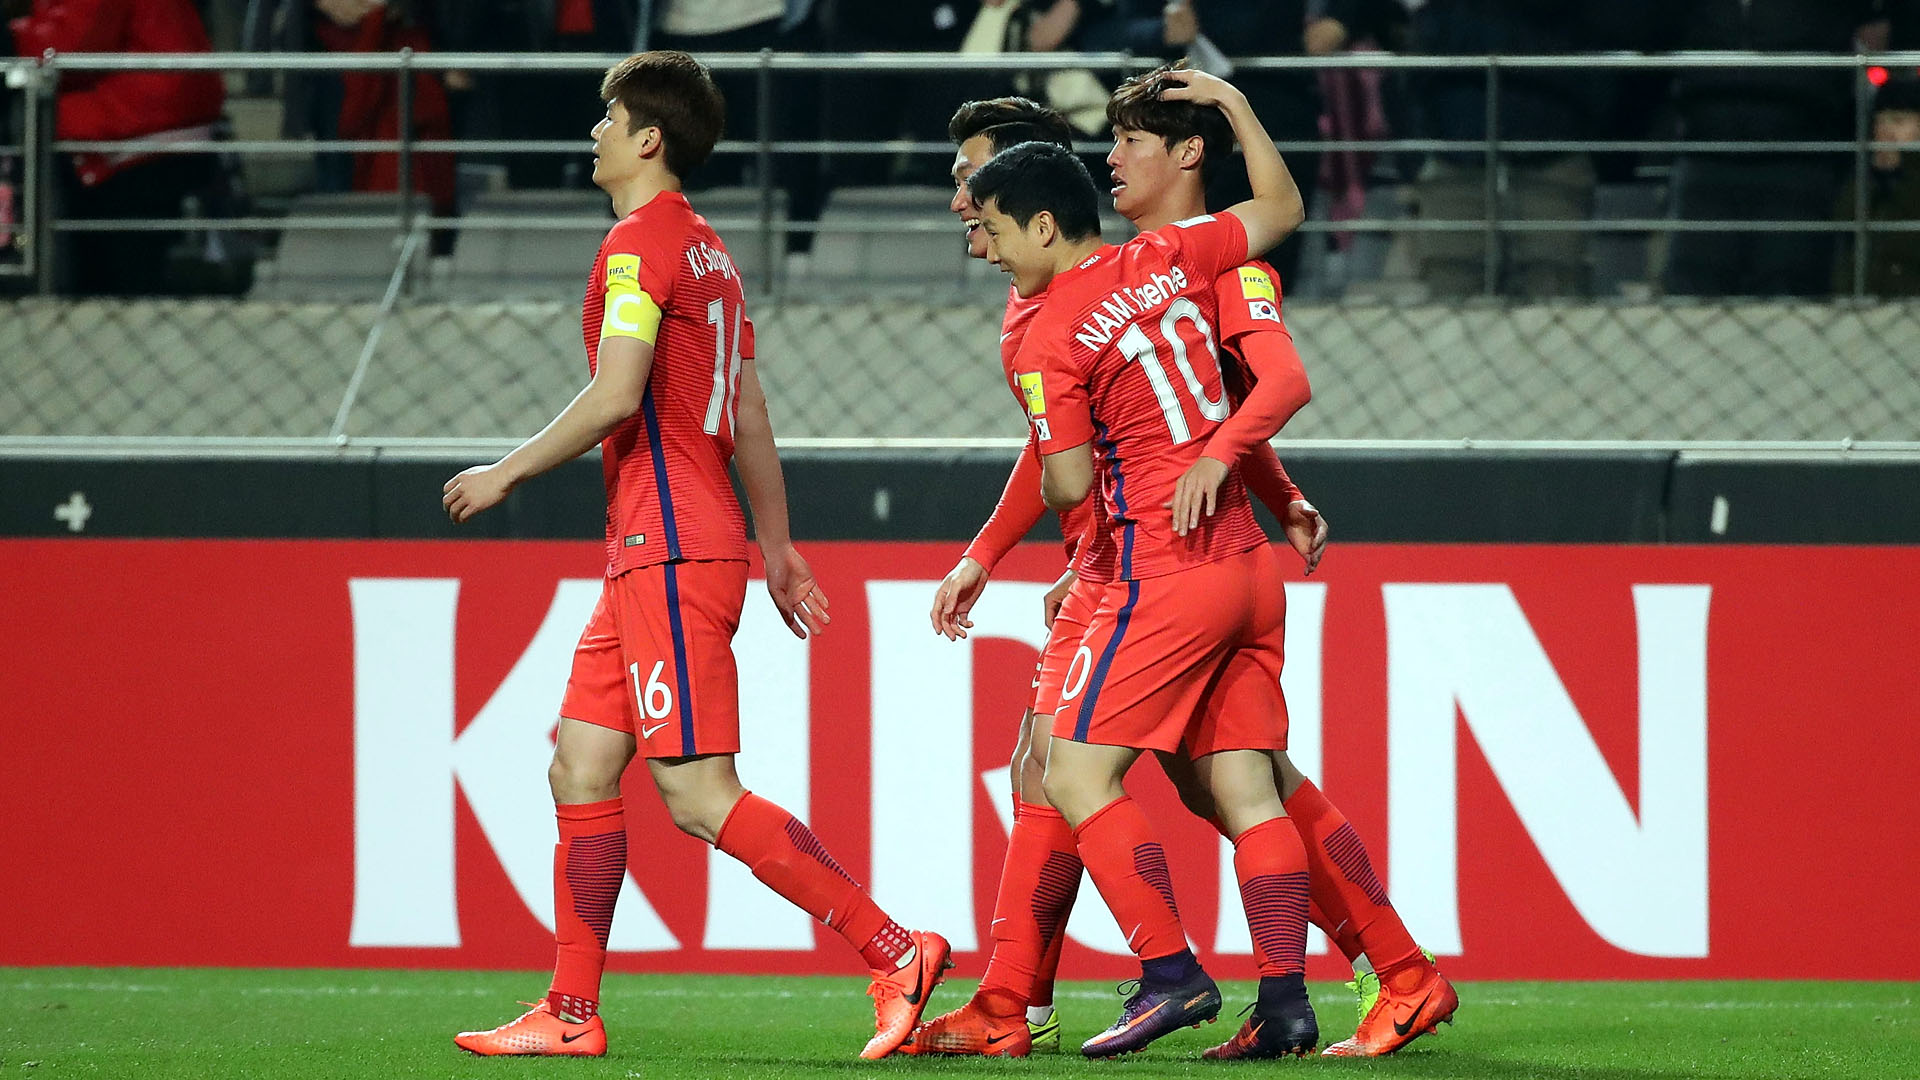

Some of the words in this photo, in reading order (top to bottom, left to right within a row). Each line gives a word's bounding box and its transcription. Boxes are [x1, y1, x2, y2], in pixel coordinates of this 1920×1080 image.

[609, 266, 624, 276] FIFA
[685, 246, 706, 280] KI
[1079, 255, 1101, 269] KOREA
[1243, 276, 1264, 284] FIFA
[611, 293, 641, 332] C
[1075, 292, 1138, 352] NAM
[1125, 266, 1188, 312] Taehe
[1116, 297, 1229, 445] 10
[629, 660, 673, 721] 16
